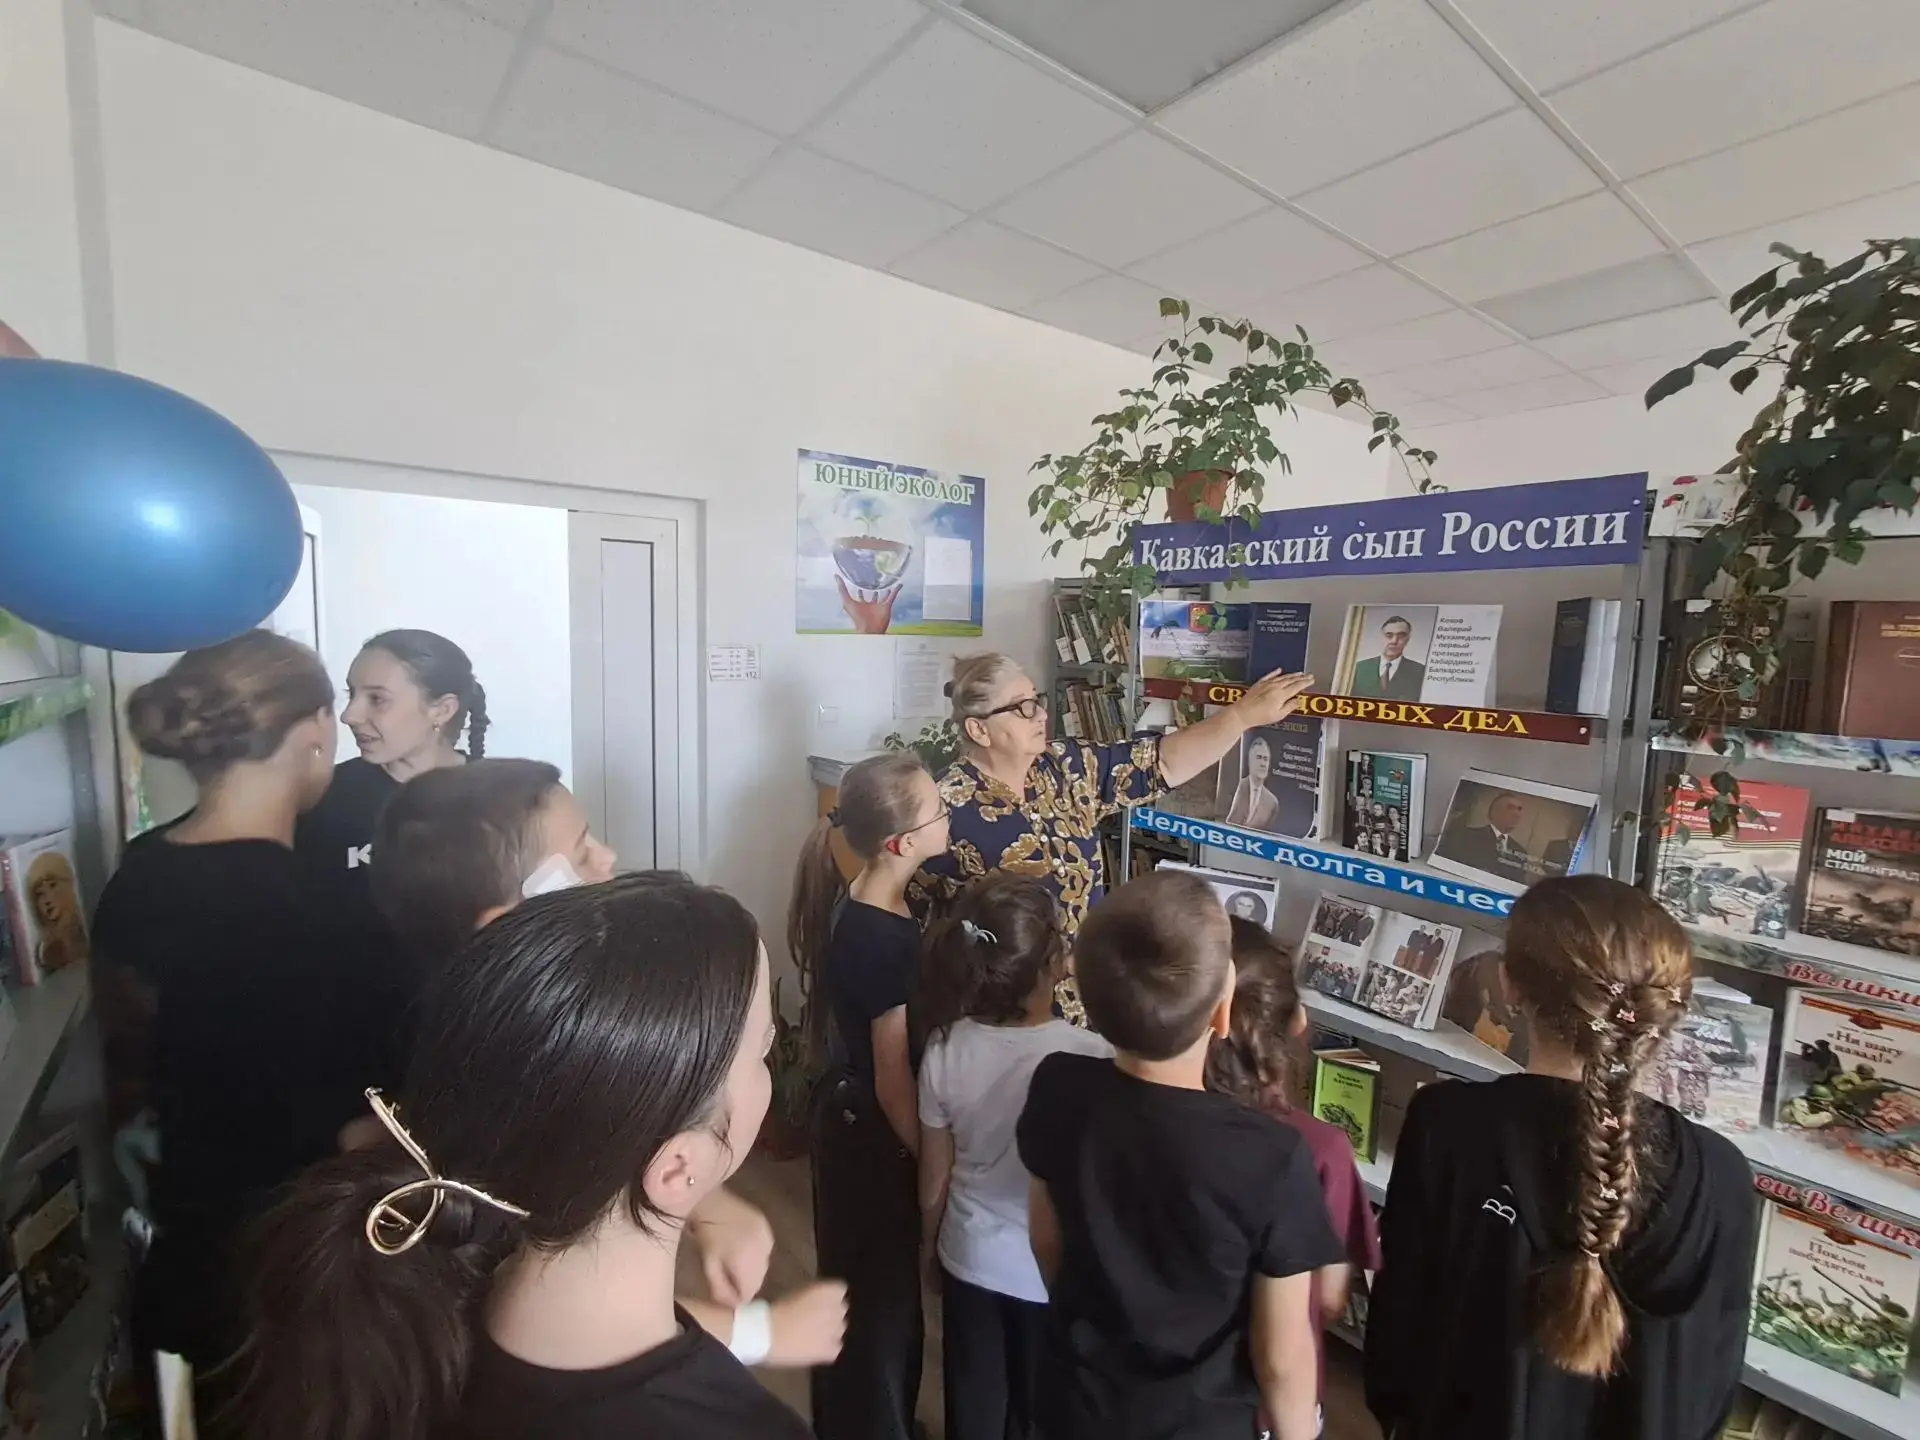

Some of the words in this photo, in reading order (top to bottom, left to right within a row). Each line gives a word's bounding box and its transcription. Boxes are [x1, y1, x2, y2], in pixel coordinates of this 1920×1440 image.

[814, 462, 891, 492] ЮНЫЙ
[895, 473, 974, 503] ЭКОЛОГ
[1139, 524, 1332, 573] Кавказский
[1342, 527, 1426, 561] сын
[1438, 511, 1631, 556] России
[1443, 709, 1529, 734] ДЕЛ
[1135, 806, 1264, 856] Человек
[1274, 847, 1386, 886] долга
[1400, 876, 1425, 895] и
[1439, 885, 1515, 915] чес
[1826, 848, 1867, 863] МОЙ
[1800, 1186, 1920, 1250] Велик
